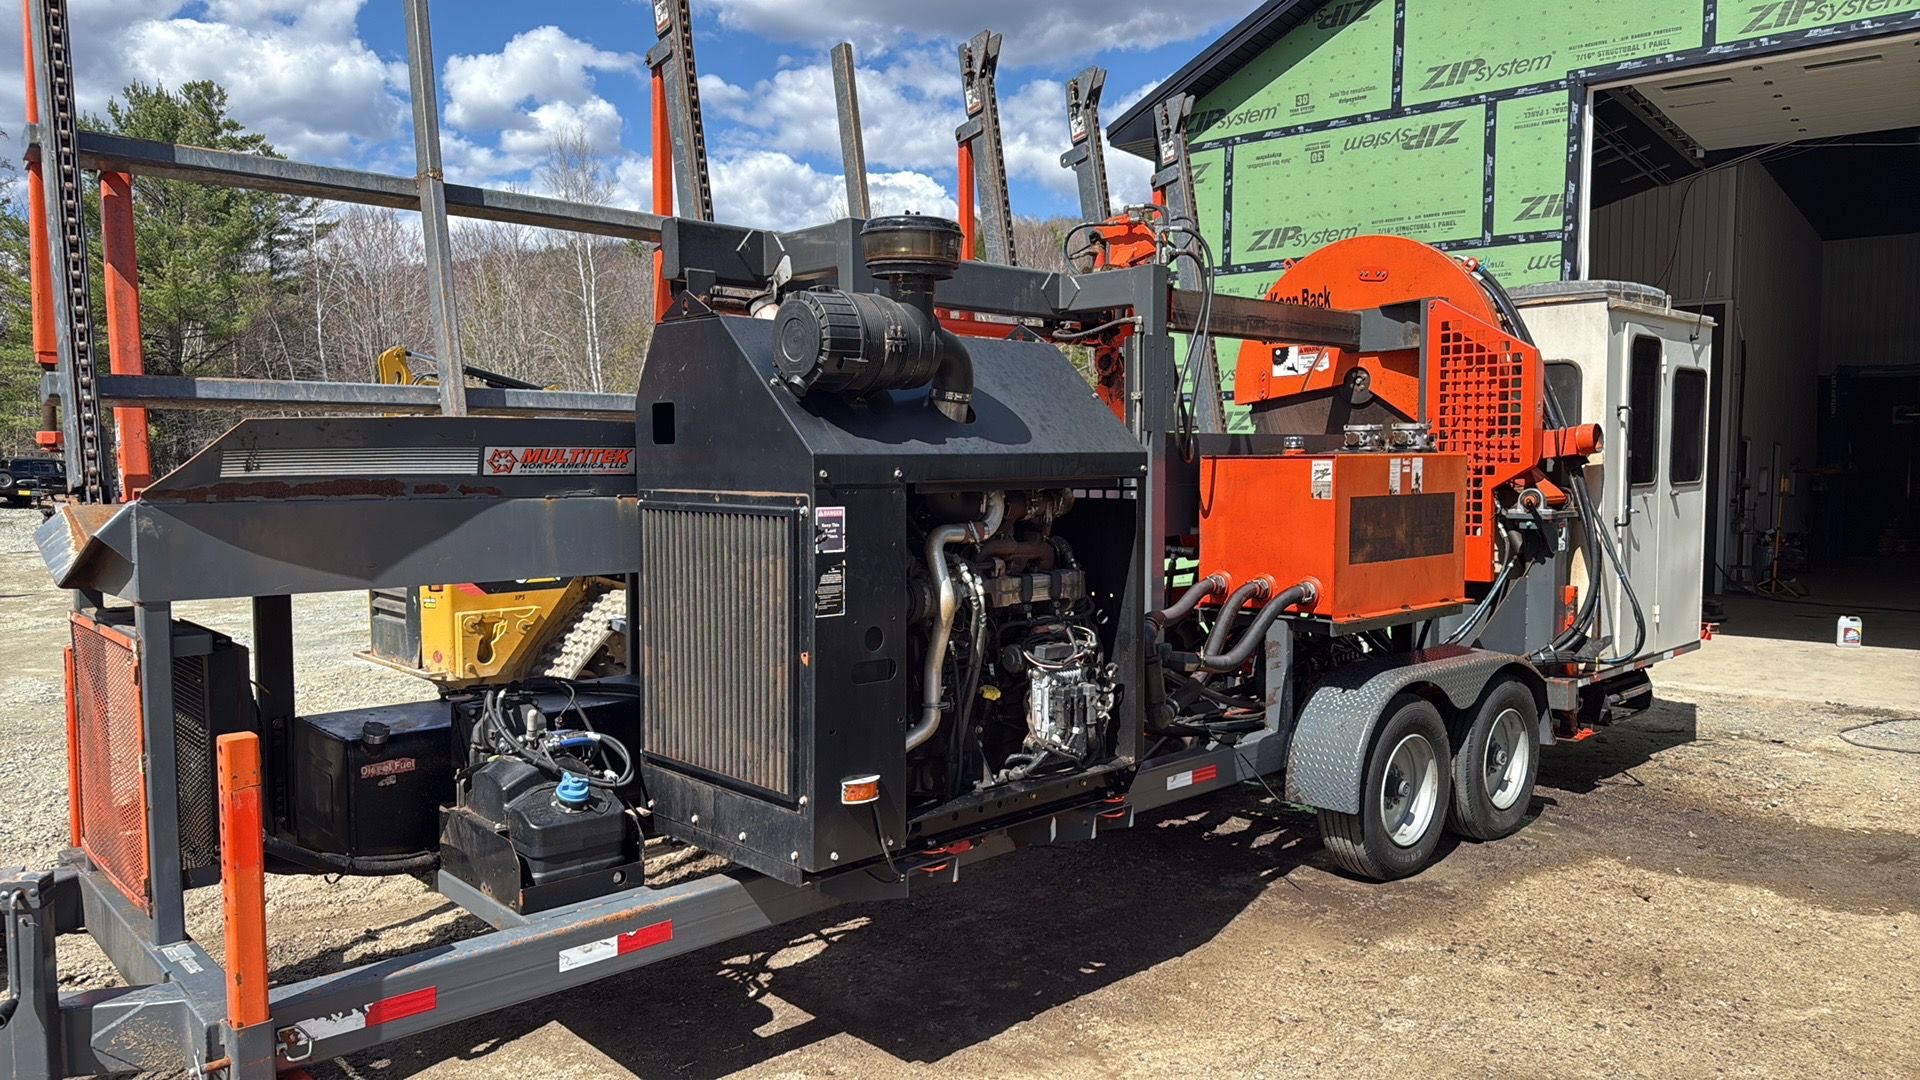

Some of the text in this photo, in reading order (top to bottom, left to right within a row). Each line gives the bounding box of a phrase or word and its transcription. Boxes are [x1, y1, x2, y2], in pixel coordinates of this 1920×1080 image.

[1597, 43, 1640, 58] STRUCTURAL
[1648, 38, 1672, 49] PANEL
[1296, 94, 1309, 106] 30
[1301, 285, 1331, 308] Back
[519, 447, 633, 463] MULTITEK
[559, 462, 607, 470] AMERICA,
[394, 759, 416, 770] Fuel
